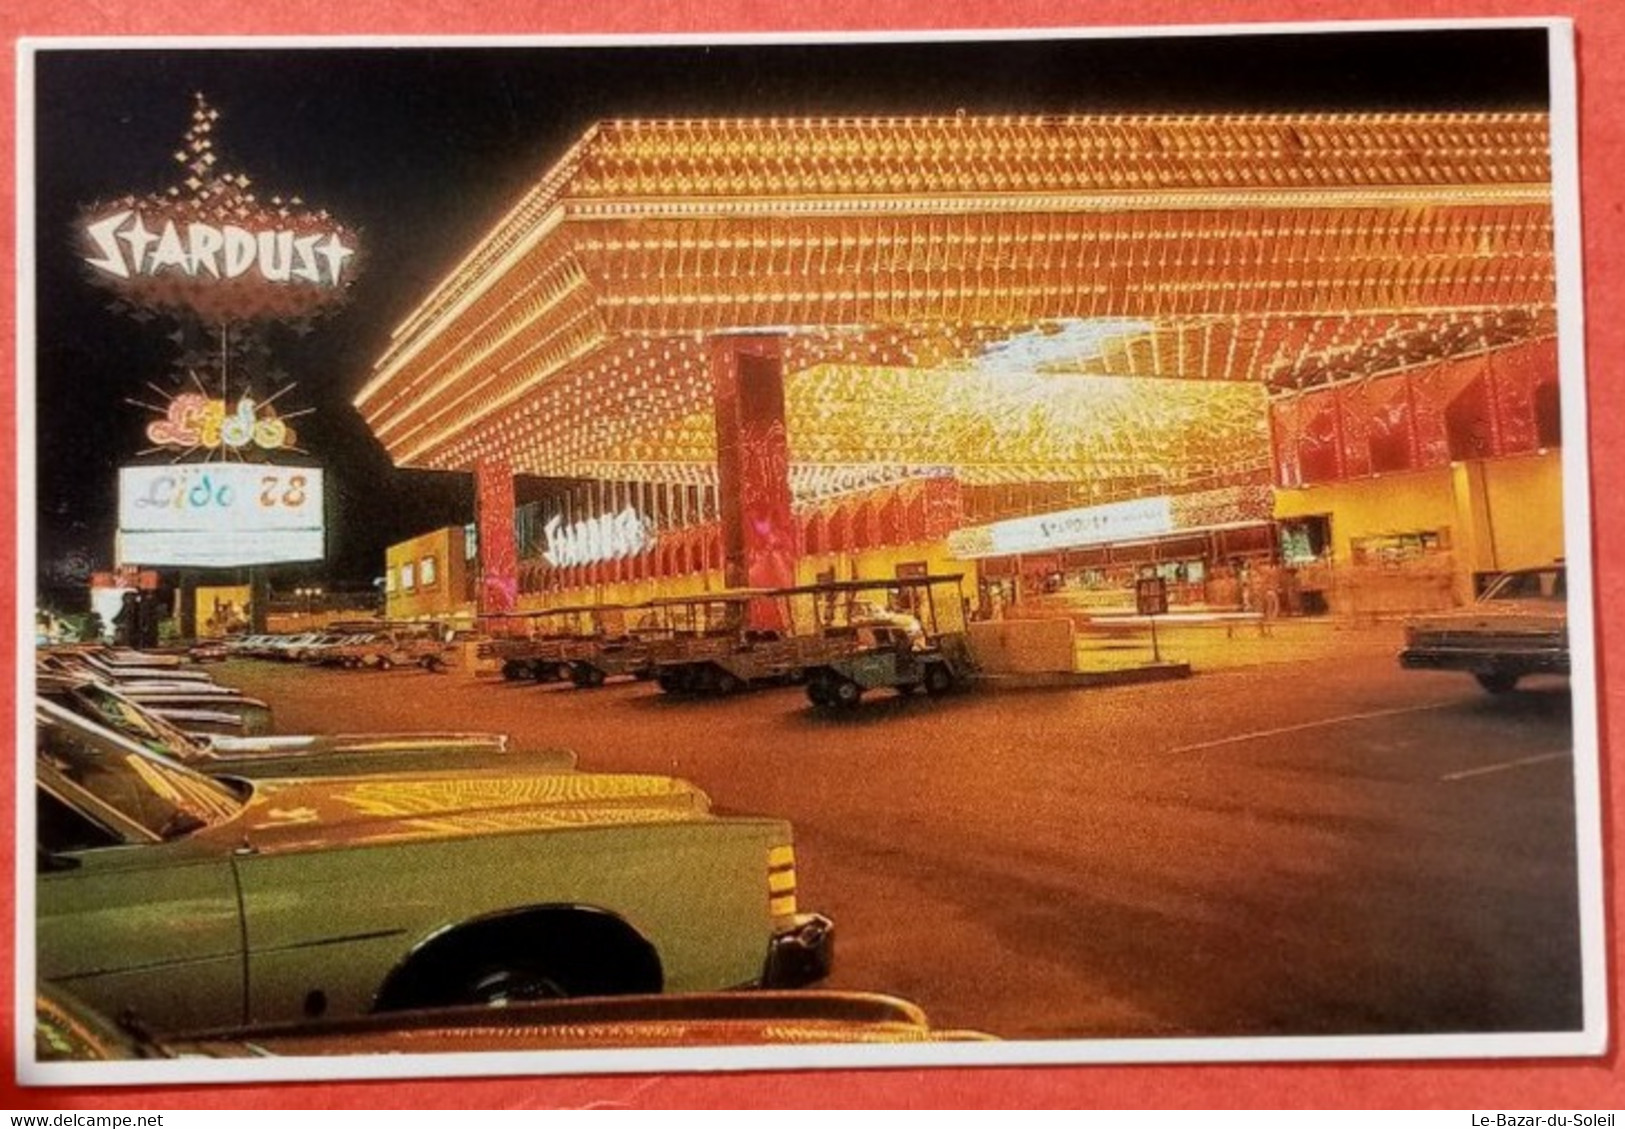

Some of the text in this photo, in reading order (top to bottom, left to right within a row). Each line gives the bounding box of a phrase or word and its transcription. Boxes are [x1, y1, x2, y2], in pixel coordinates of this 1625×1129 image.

[84, 210, 355, 287] STARDUST
[147, 393, 297, 449] Lido
[134, 473, 234, 509] Lido
